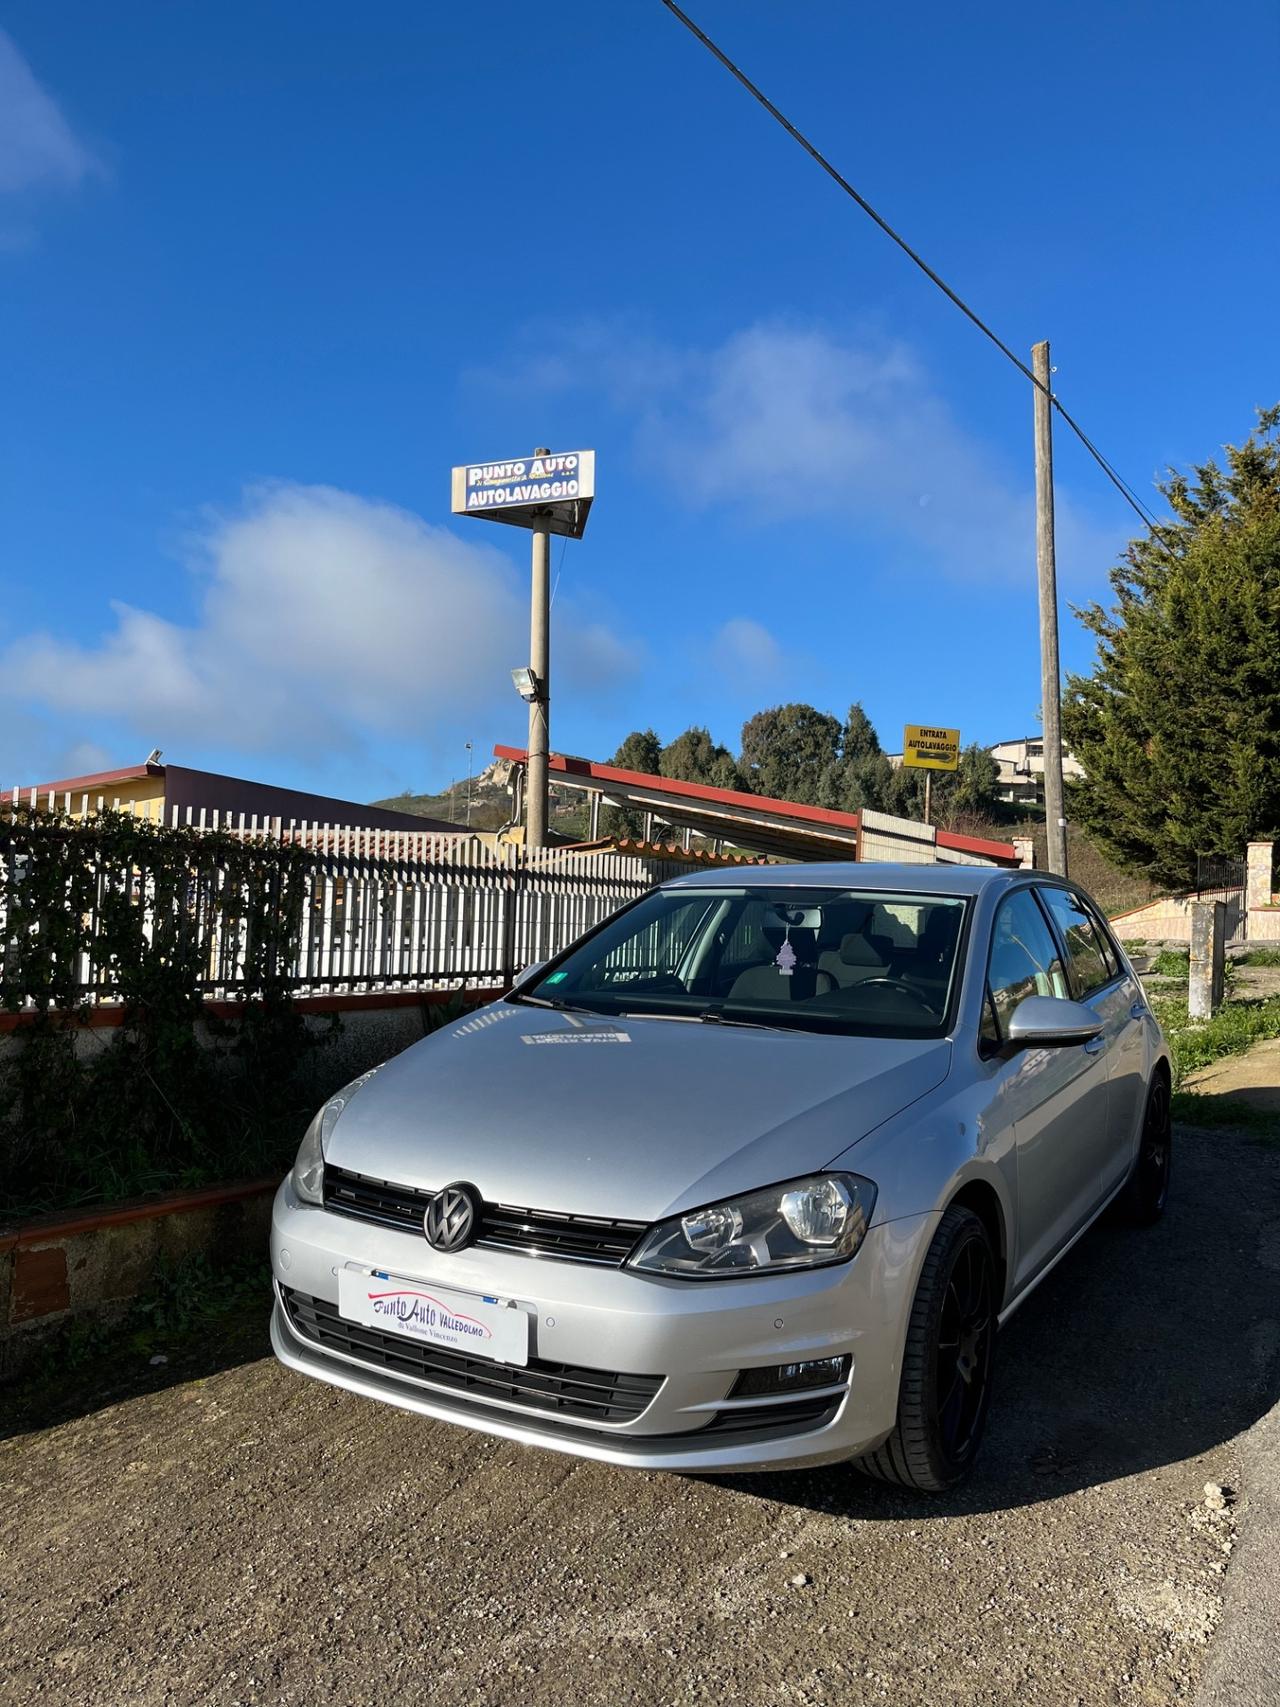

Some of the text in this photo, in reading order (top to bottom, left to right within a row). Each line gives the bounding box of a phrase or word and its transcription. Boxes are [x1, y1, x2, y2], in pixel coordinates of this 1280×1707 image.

[469, 463, 526, 486] PUNTO
[531, 456, 578, 475] AUTO
[468, 480, 578, 506] AUTOLAVAGGIO
[909, 740, 957, 752] AUTOLAVAGGIO
[920, 729, 947, 738] ENTRATA
[373, 1296, 484, 1337] Punto Auto VALLEDOLMO
